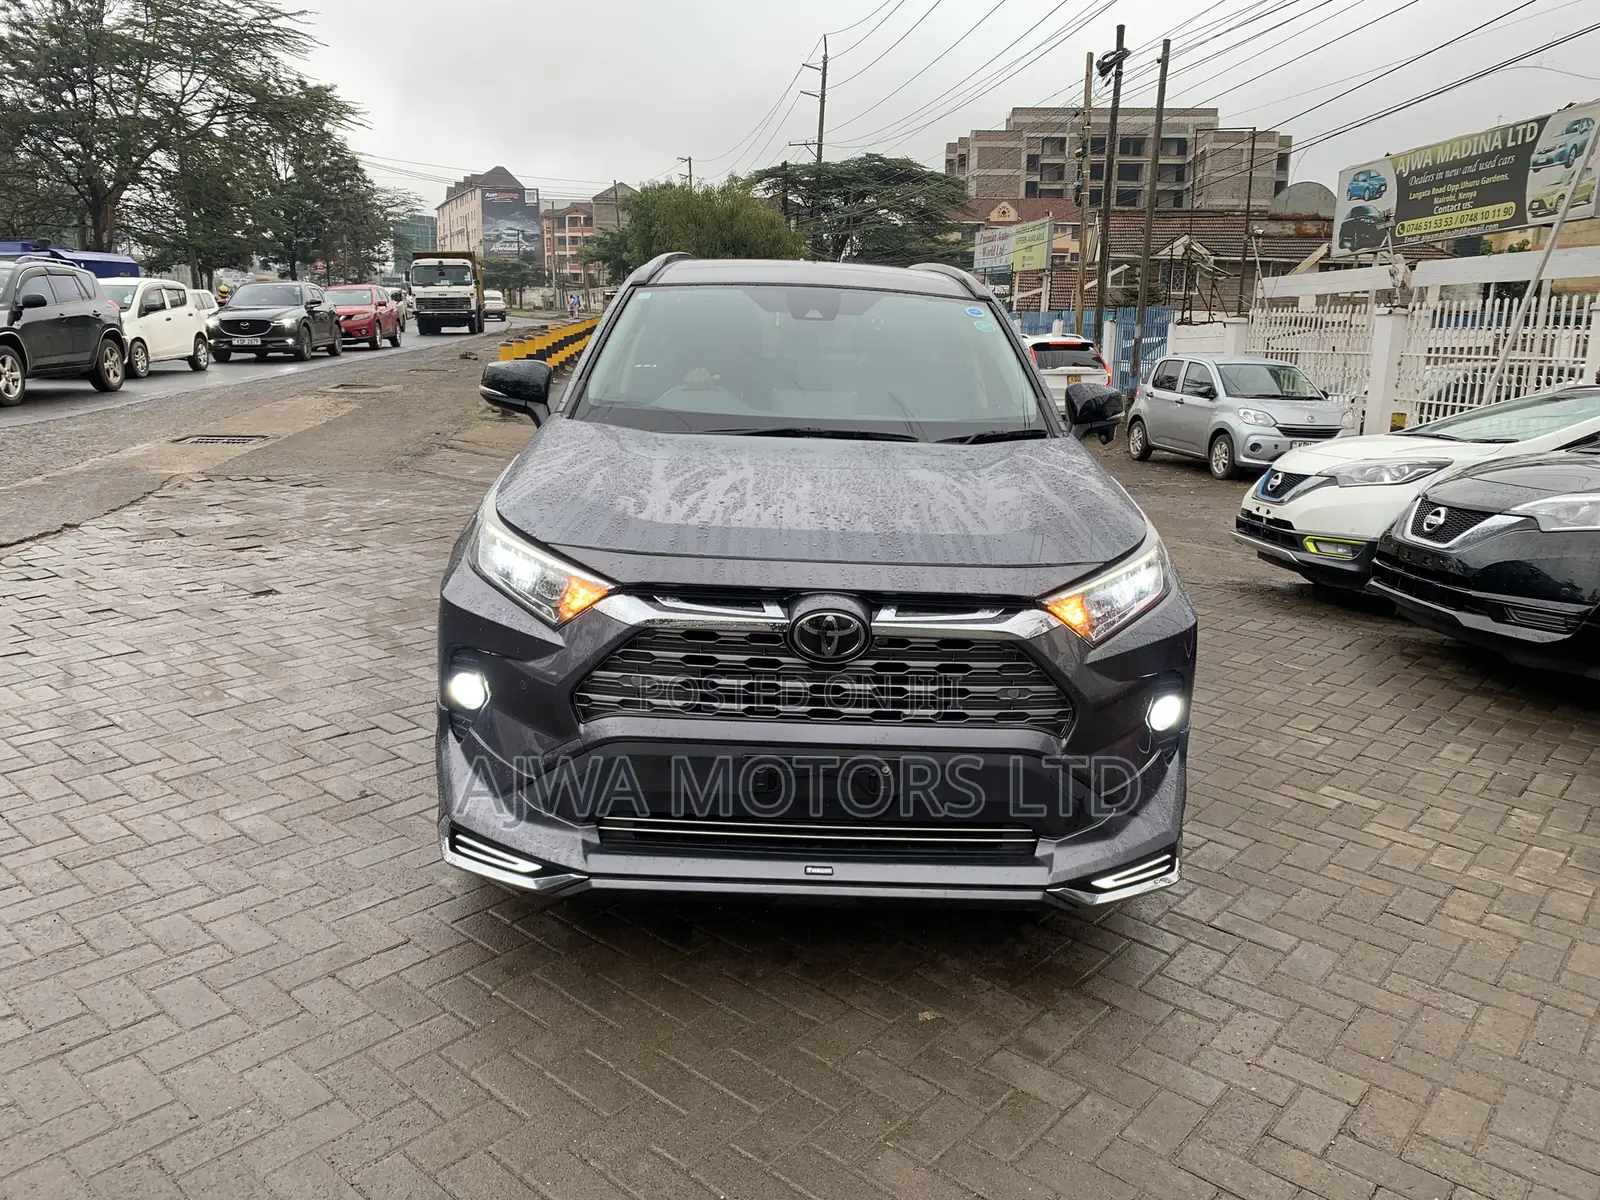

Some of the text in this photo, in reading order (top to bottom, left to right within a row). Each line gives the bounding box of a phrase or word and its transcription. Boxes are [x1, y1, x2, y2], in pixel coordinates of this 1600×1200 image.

[1396, 121, 1539, 177] AJWA MADINA LTD
[1408, 154, 1516, 187] Dealers in new and used cars
[1409, 189, 1431, 200] Langata
[1431, 184, 1447, 194] Road
[1458, 190, 1477, 201] Kenya
[1433, 200, 1474, 215] Contact us:
[1406, 221, 1423, 233] 0746
[1423, 220, 1432, 230] 51
[1433, 218, 1442, 228] 53
[1443, 216, 1453, 226] 53
[1459, 213, 1478, 224] 0748
[1480, 210, 1490, 220] 10
[1491, 208, 1501, 218] 11
[1503, 205, 1514, 216] 90
